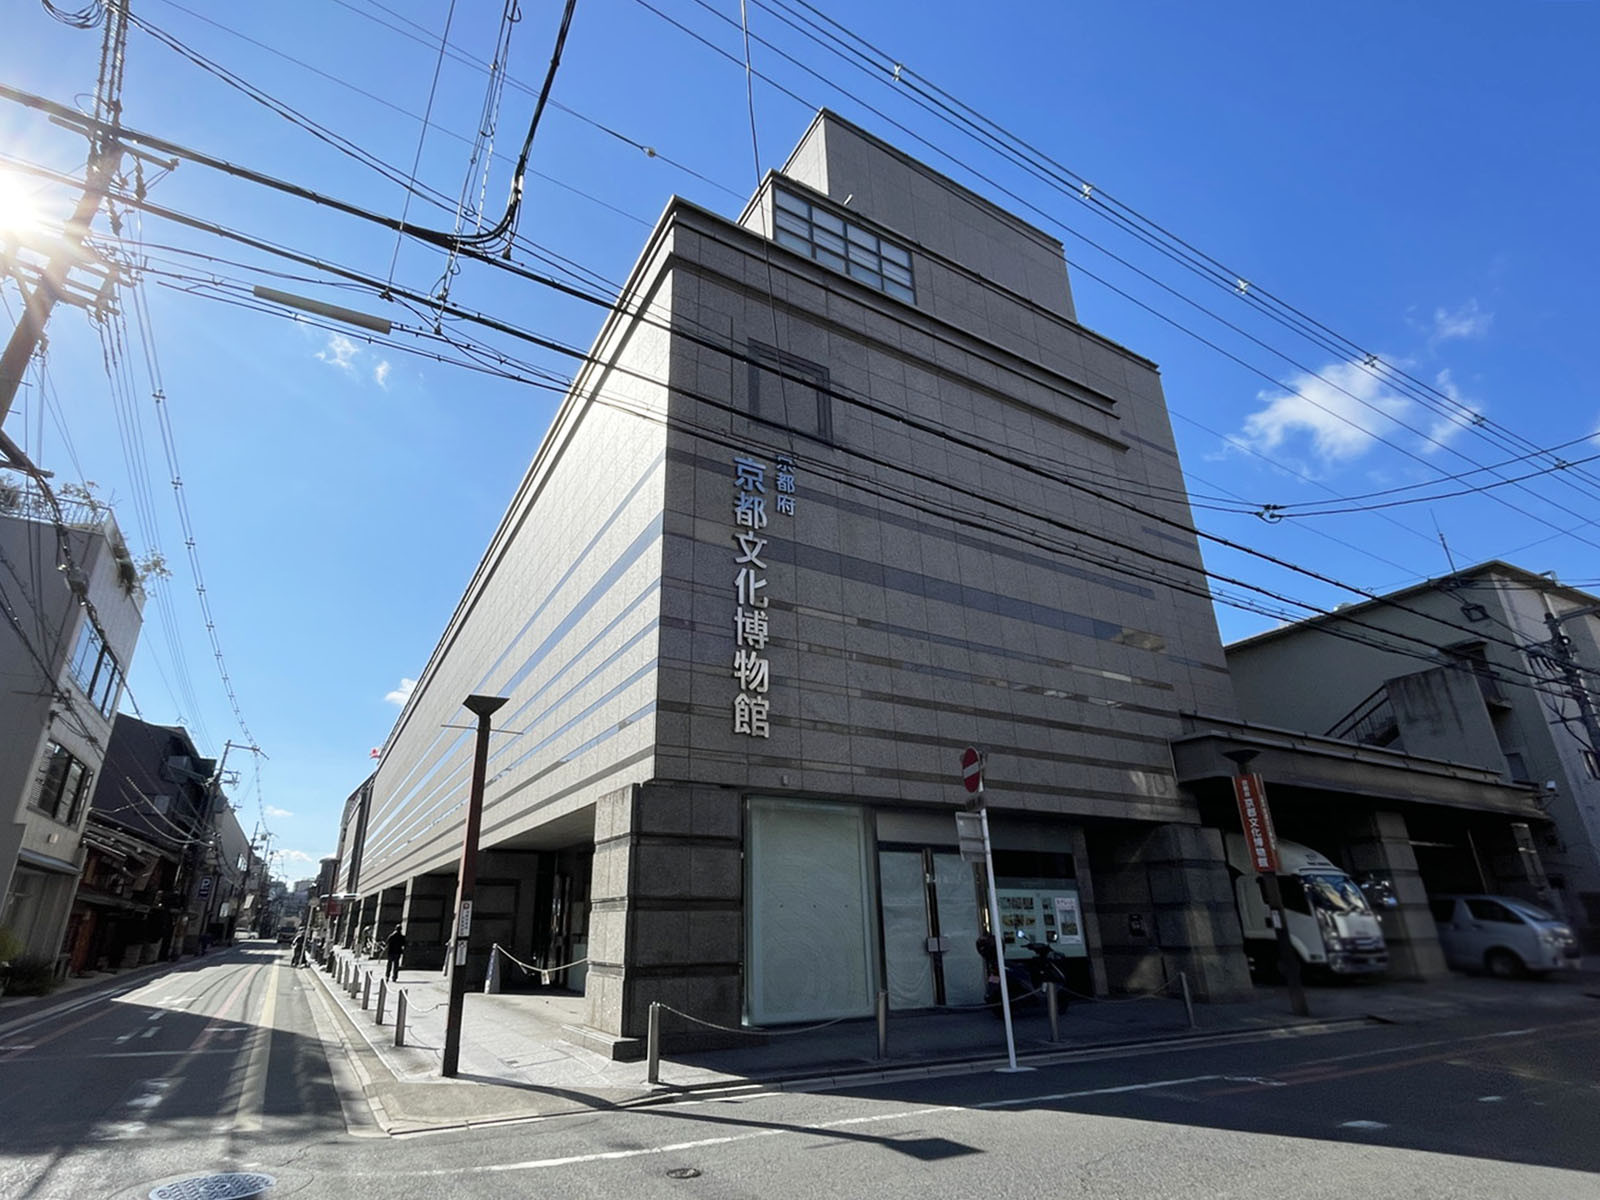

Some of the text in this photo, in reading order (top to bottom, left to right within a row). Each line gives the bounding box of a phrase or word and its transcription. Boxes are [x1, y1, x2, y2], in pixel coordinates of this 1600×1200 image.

[733, 457, 769, 738] 京都文化博物館
[201, 878, 211, 889] P
